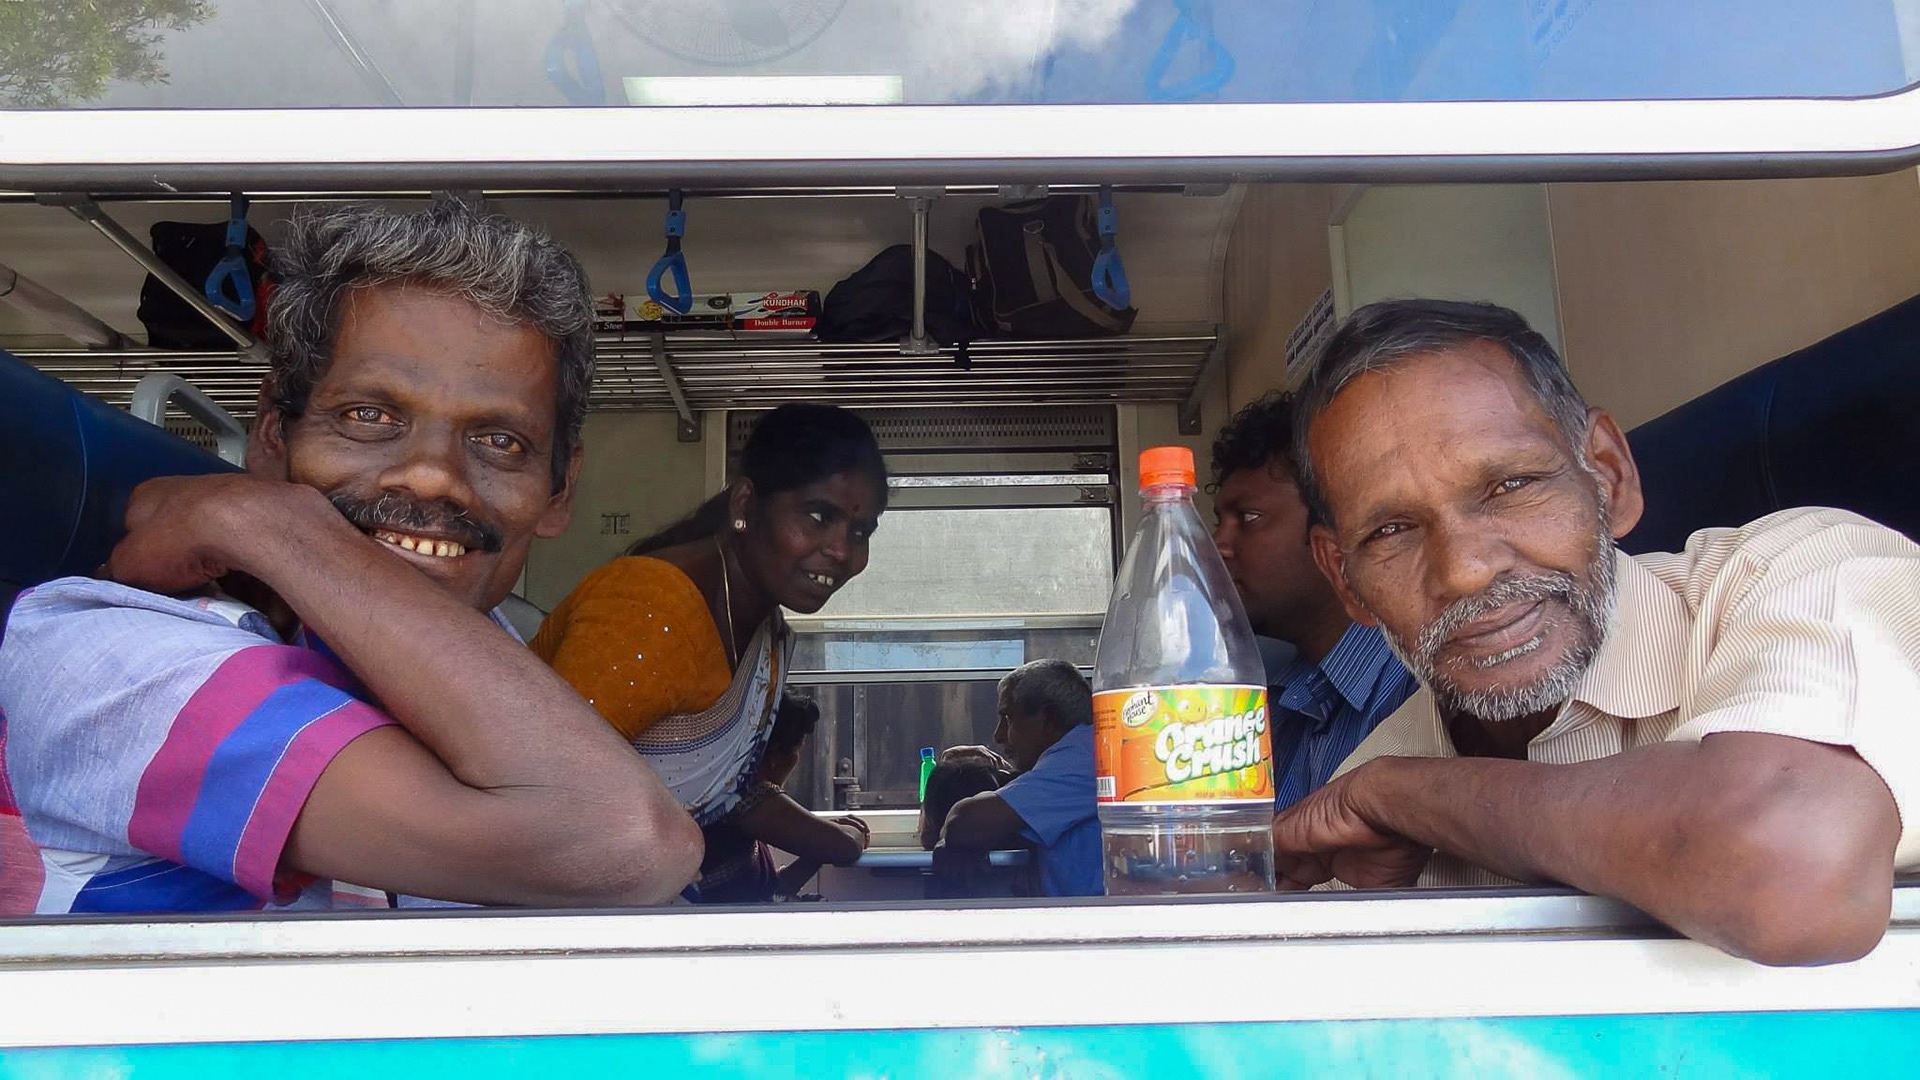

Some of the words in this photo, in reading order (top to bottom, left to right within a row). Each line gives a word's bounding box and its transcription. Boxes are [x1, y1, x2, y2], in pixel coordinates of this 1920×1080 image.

[763, 299, 806, 307] KUNDHAN
[603, 322, 624, 330] Stee
[1155, 705, 1266, 763] Orange
[1166, 731, 1261, 783] Crush
